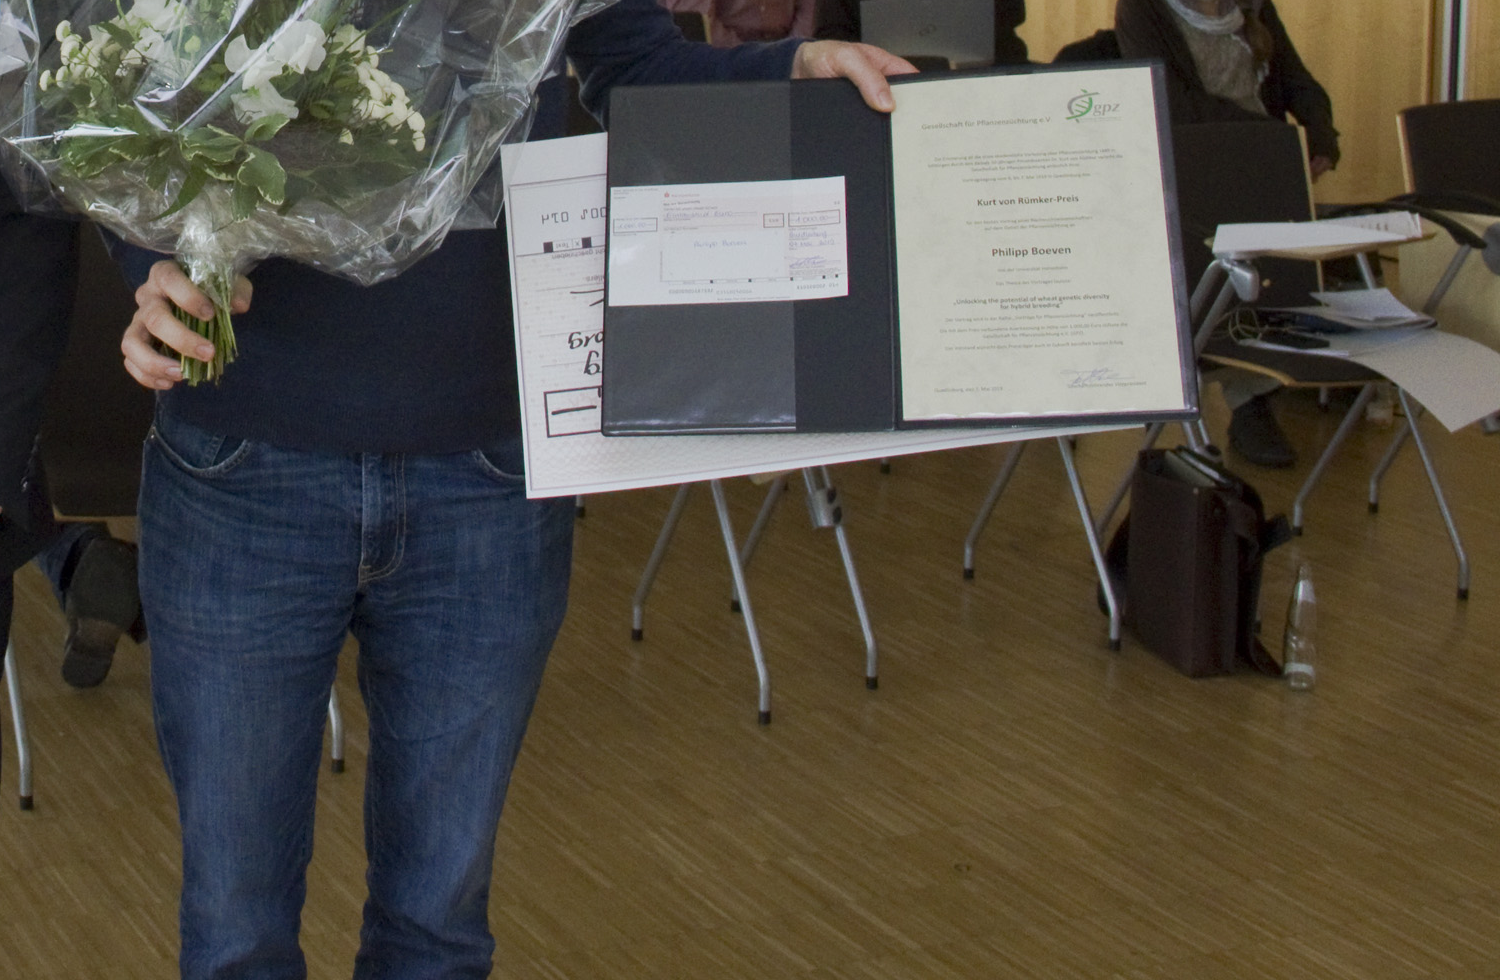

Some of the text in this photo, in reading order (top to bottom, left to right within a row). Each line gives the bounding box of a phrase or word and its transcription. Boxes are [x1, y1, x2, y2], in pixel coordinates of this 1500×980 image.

[1092, 103, 1120, 117] gpz
[921, 121, 964, 130] Gesellschaft
[976, 117, 1038, 126] Pflanzenzüchtung
[976, 194, 1080, 207] Kurt von Rümker-Preis
[991, 245, 1072, 258] Philipp Boeven
[1000, 296, 1029, 304] potential
[1058, 294, 1081, 302] genetic
[1083, 293, 1110, 301] diversity
